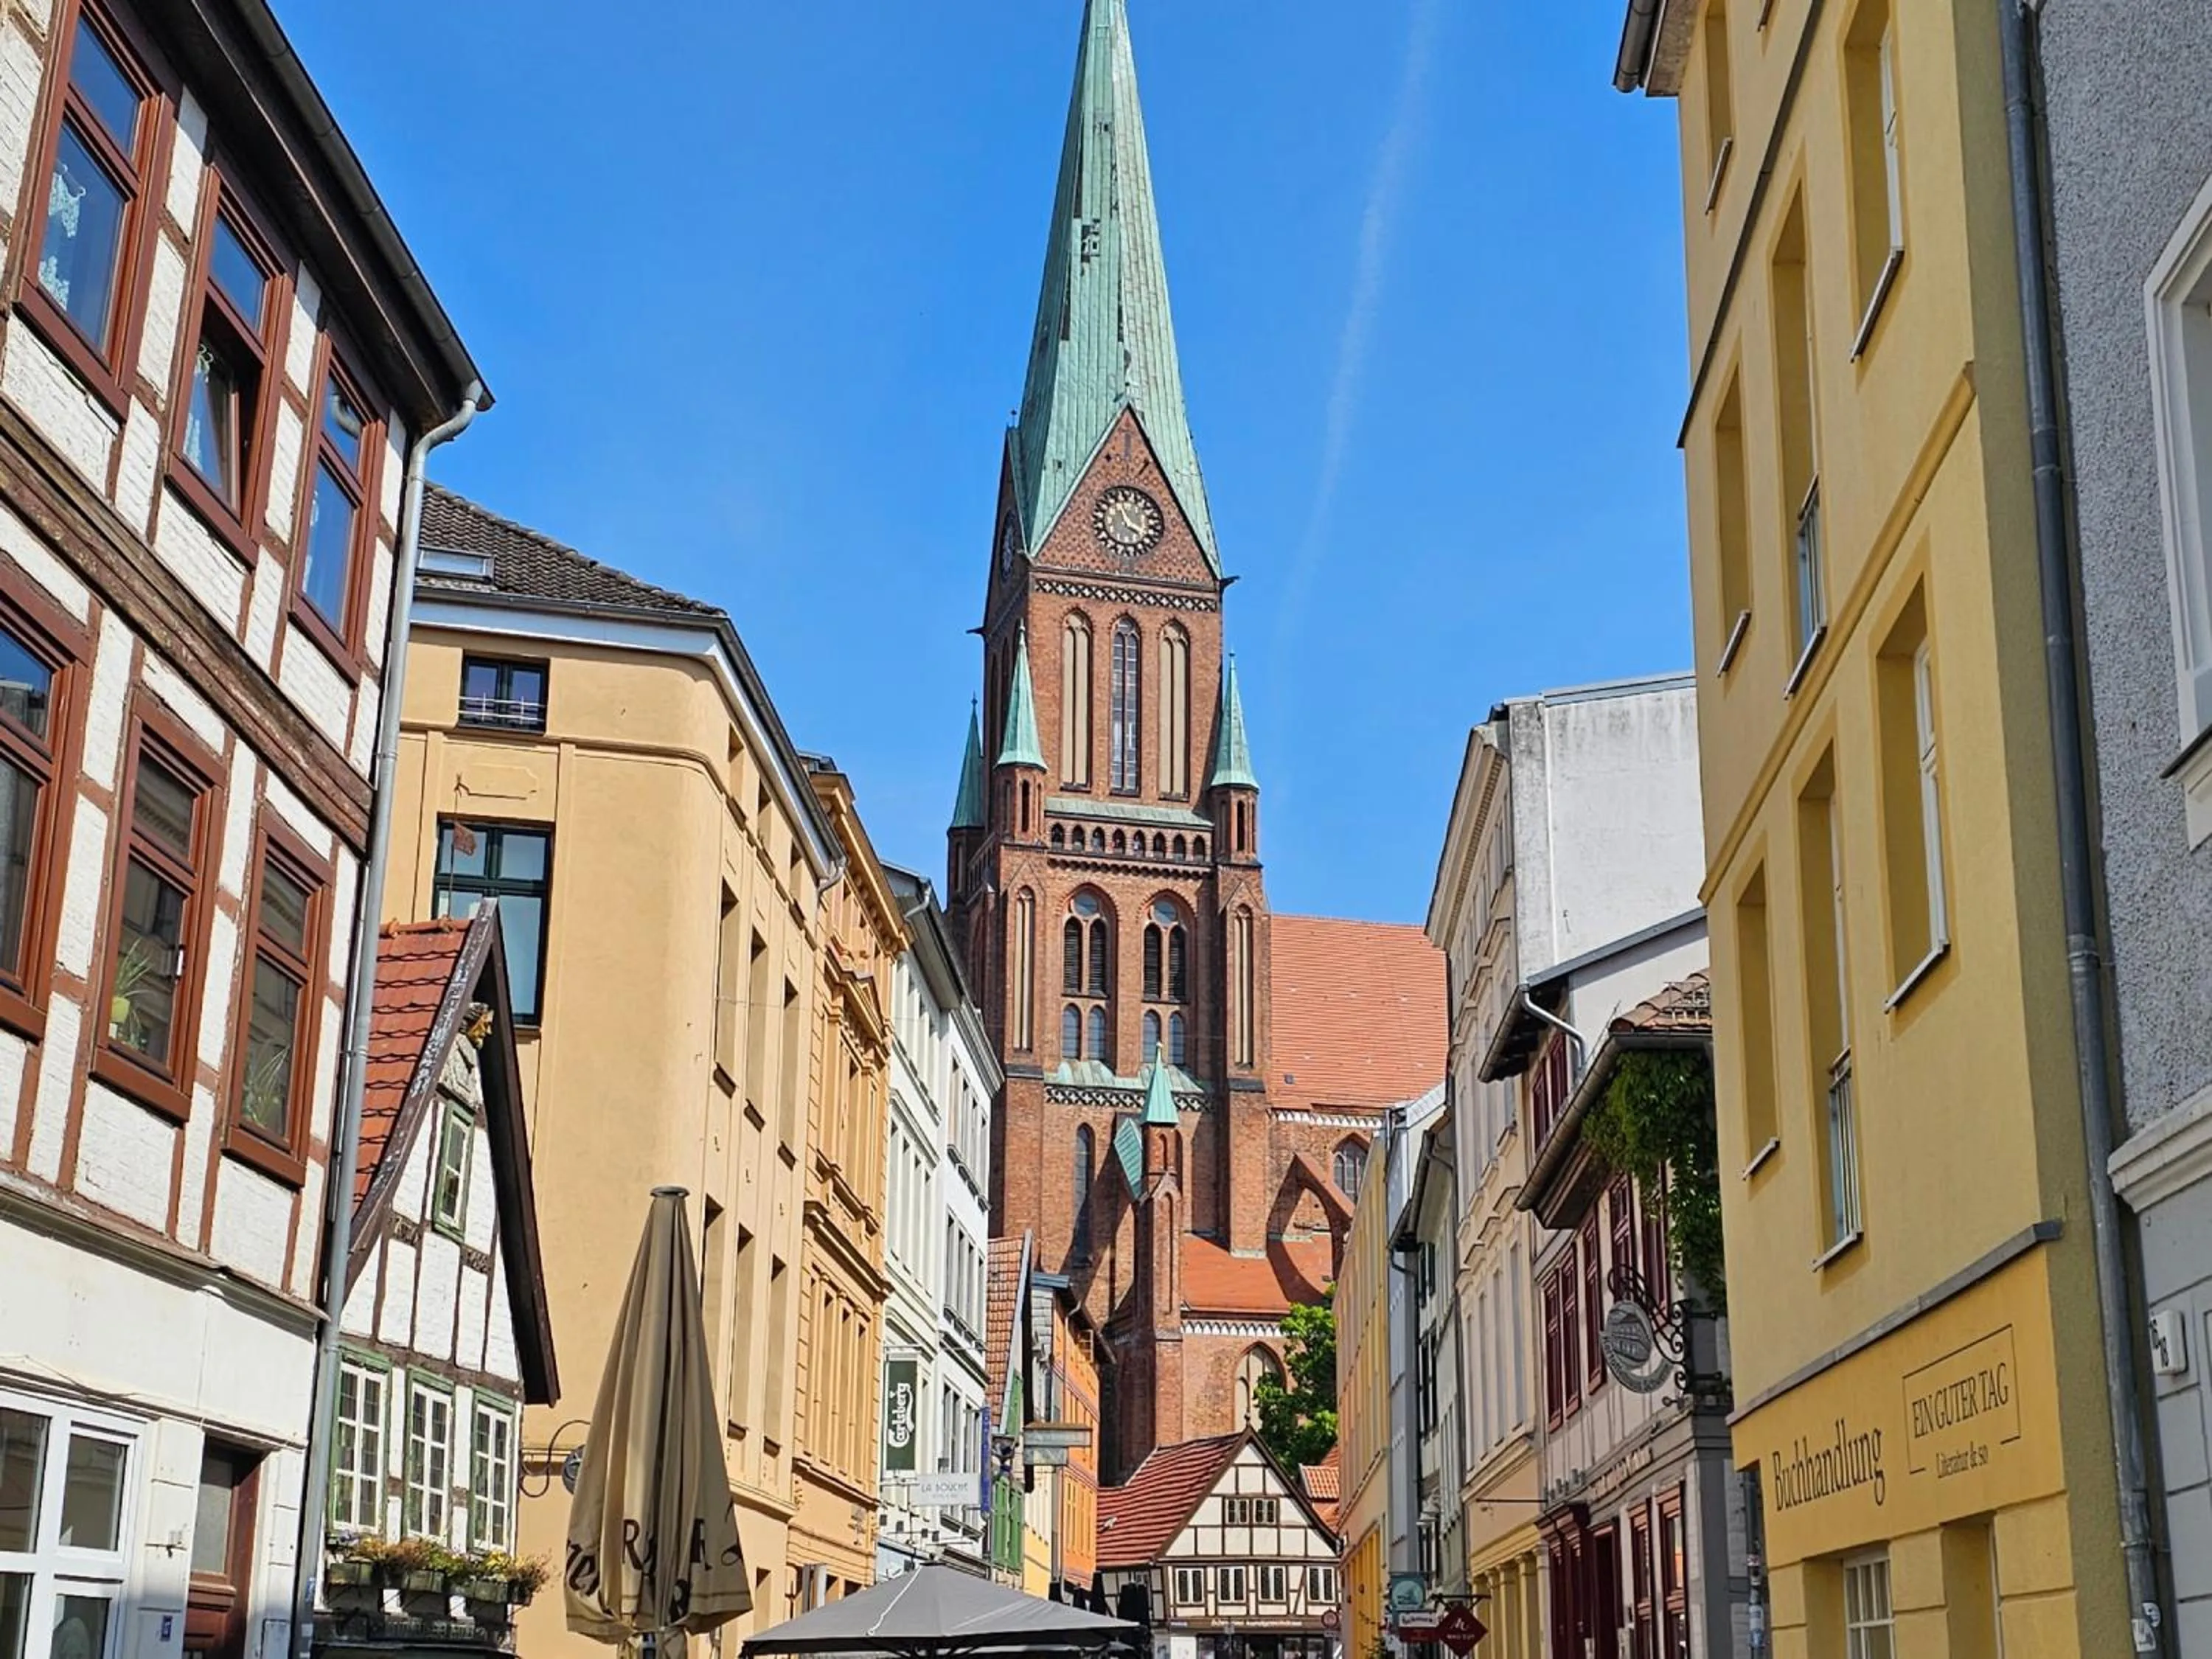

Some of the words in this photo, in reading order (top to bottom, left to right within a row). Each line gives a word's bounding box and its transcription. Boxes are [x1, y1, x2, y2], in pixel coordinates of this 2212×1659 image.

[888, 1382, 914, 1448] Carlsberg
[1912, 1394, 1935, 1439] EIN
[1935, 1376, 1978, 1430] GUTER
[1979, 1362, 2008, 1413] TAG
[1773, 1416, 1885, 1512] Buchhandlung
